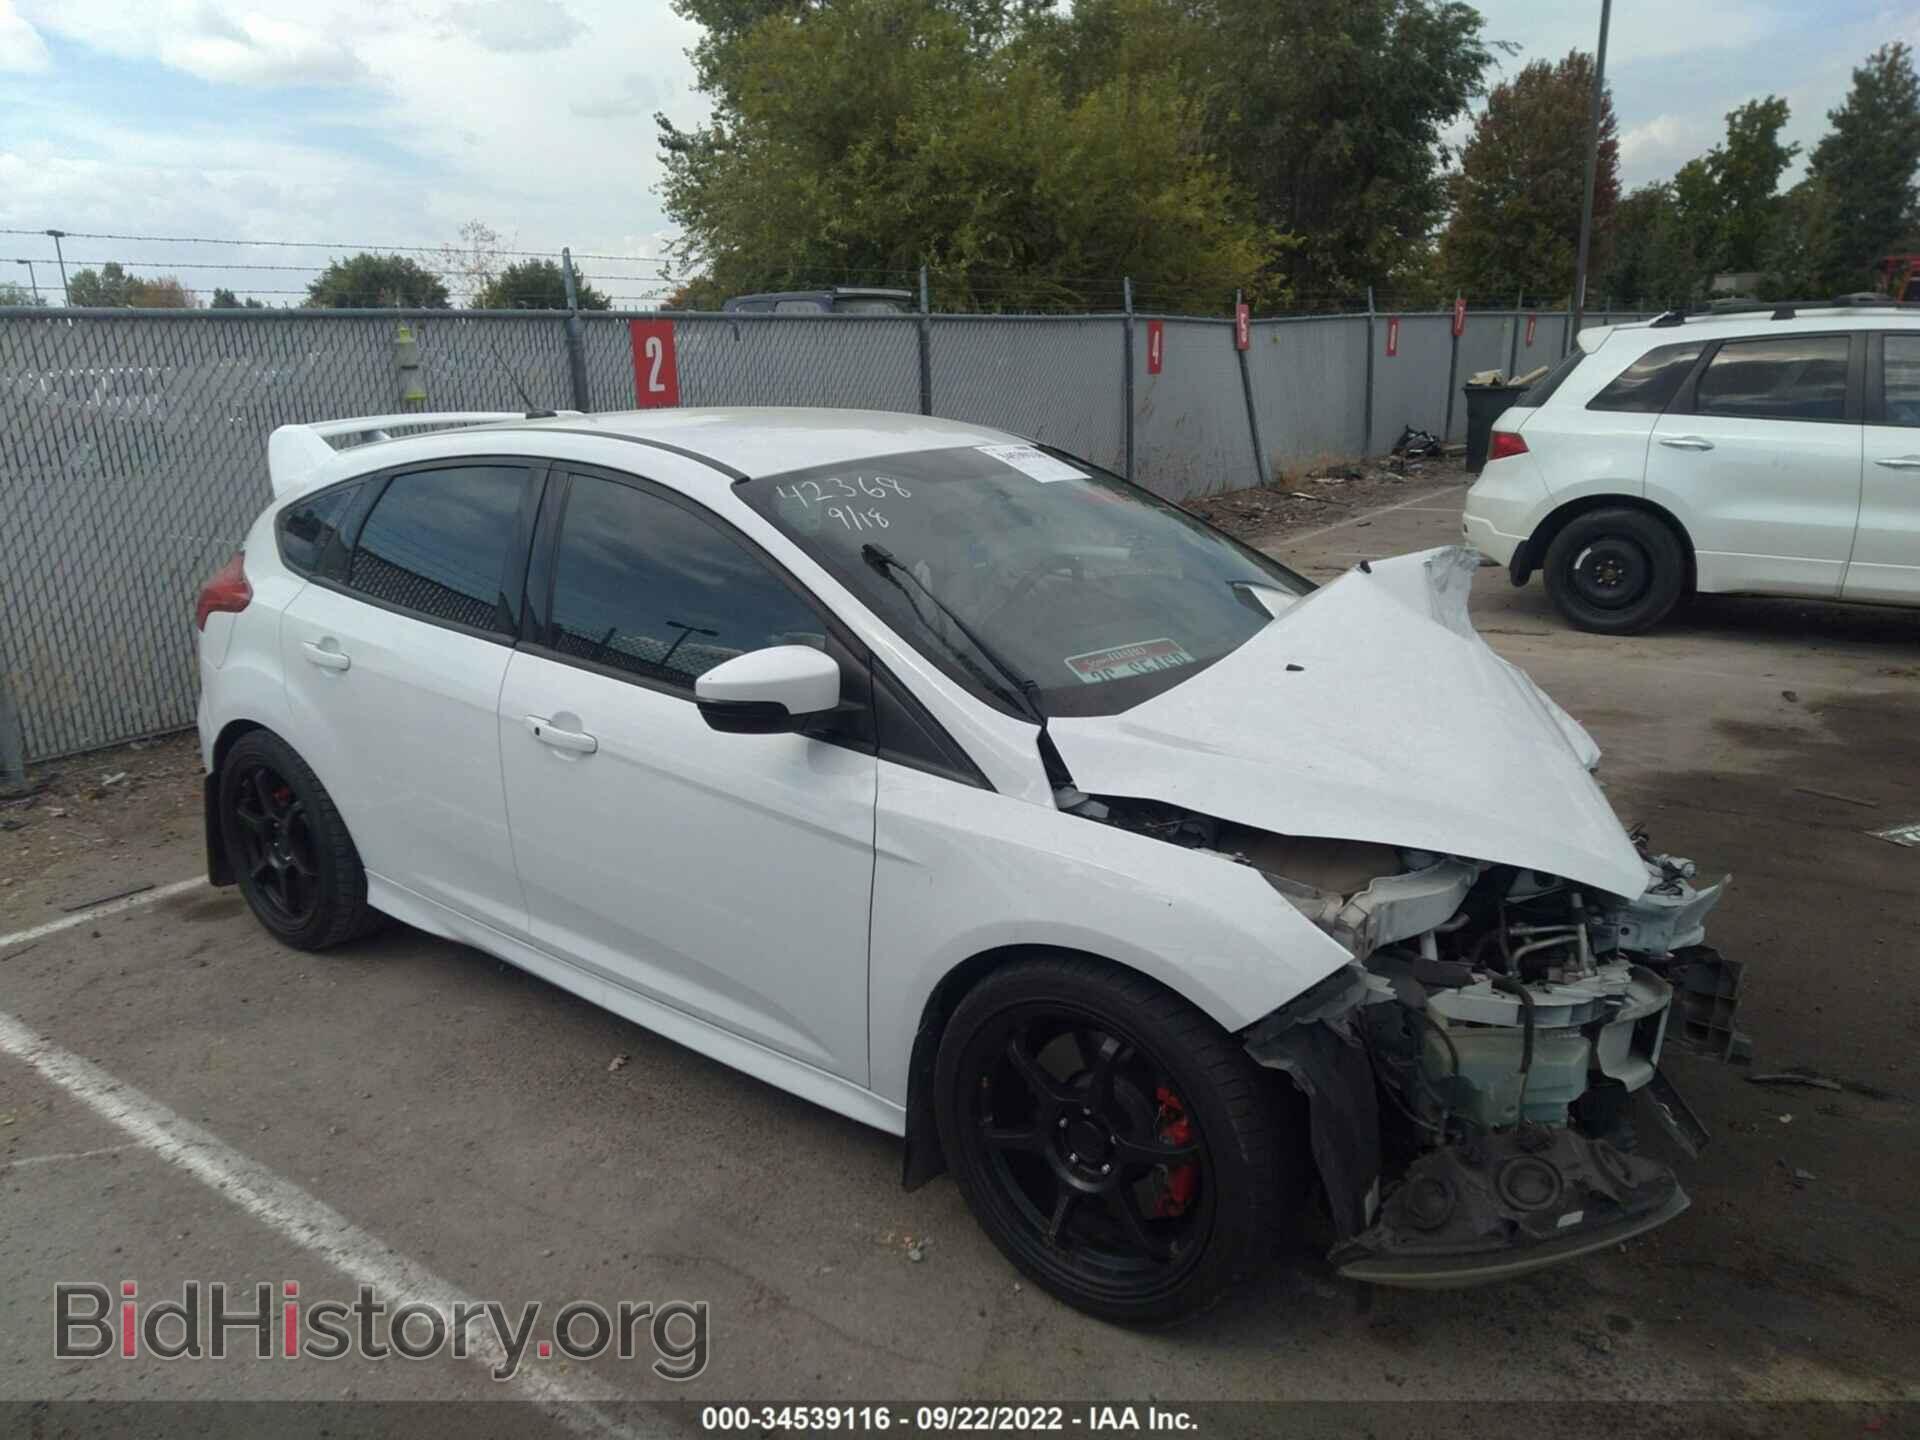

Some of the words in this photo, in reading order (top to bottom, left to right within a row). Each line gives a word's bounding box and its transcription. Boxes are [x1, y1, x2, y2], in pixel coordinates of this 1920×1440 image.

[645, 336, 665, 392] 2
[1152, 330, 1159, 365] 4
[775, 475, 913, 509] 42368
[827, 506, 889, 531] 9/18
